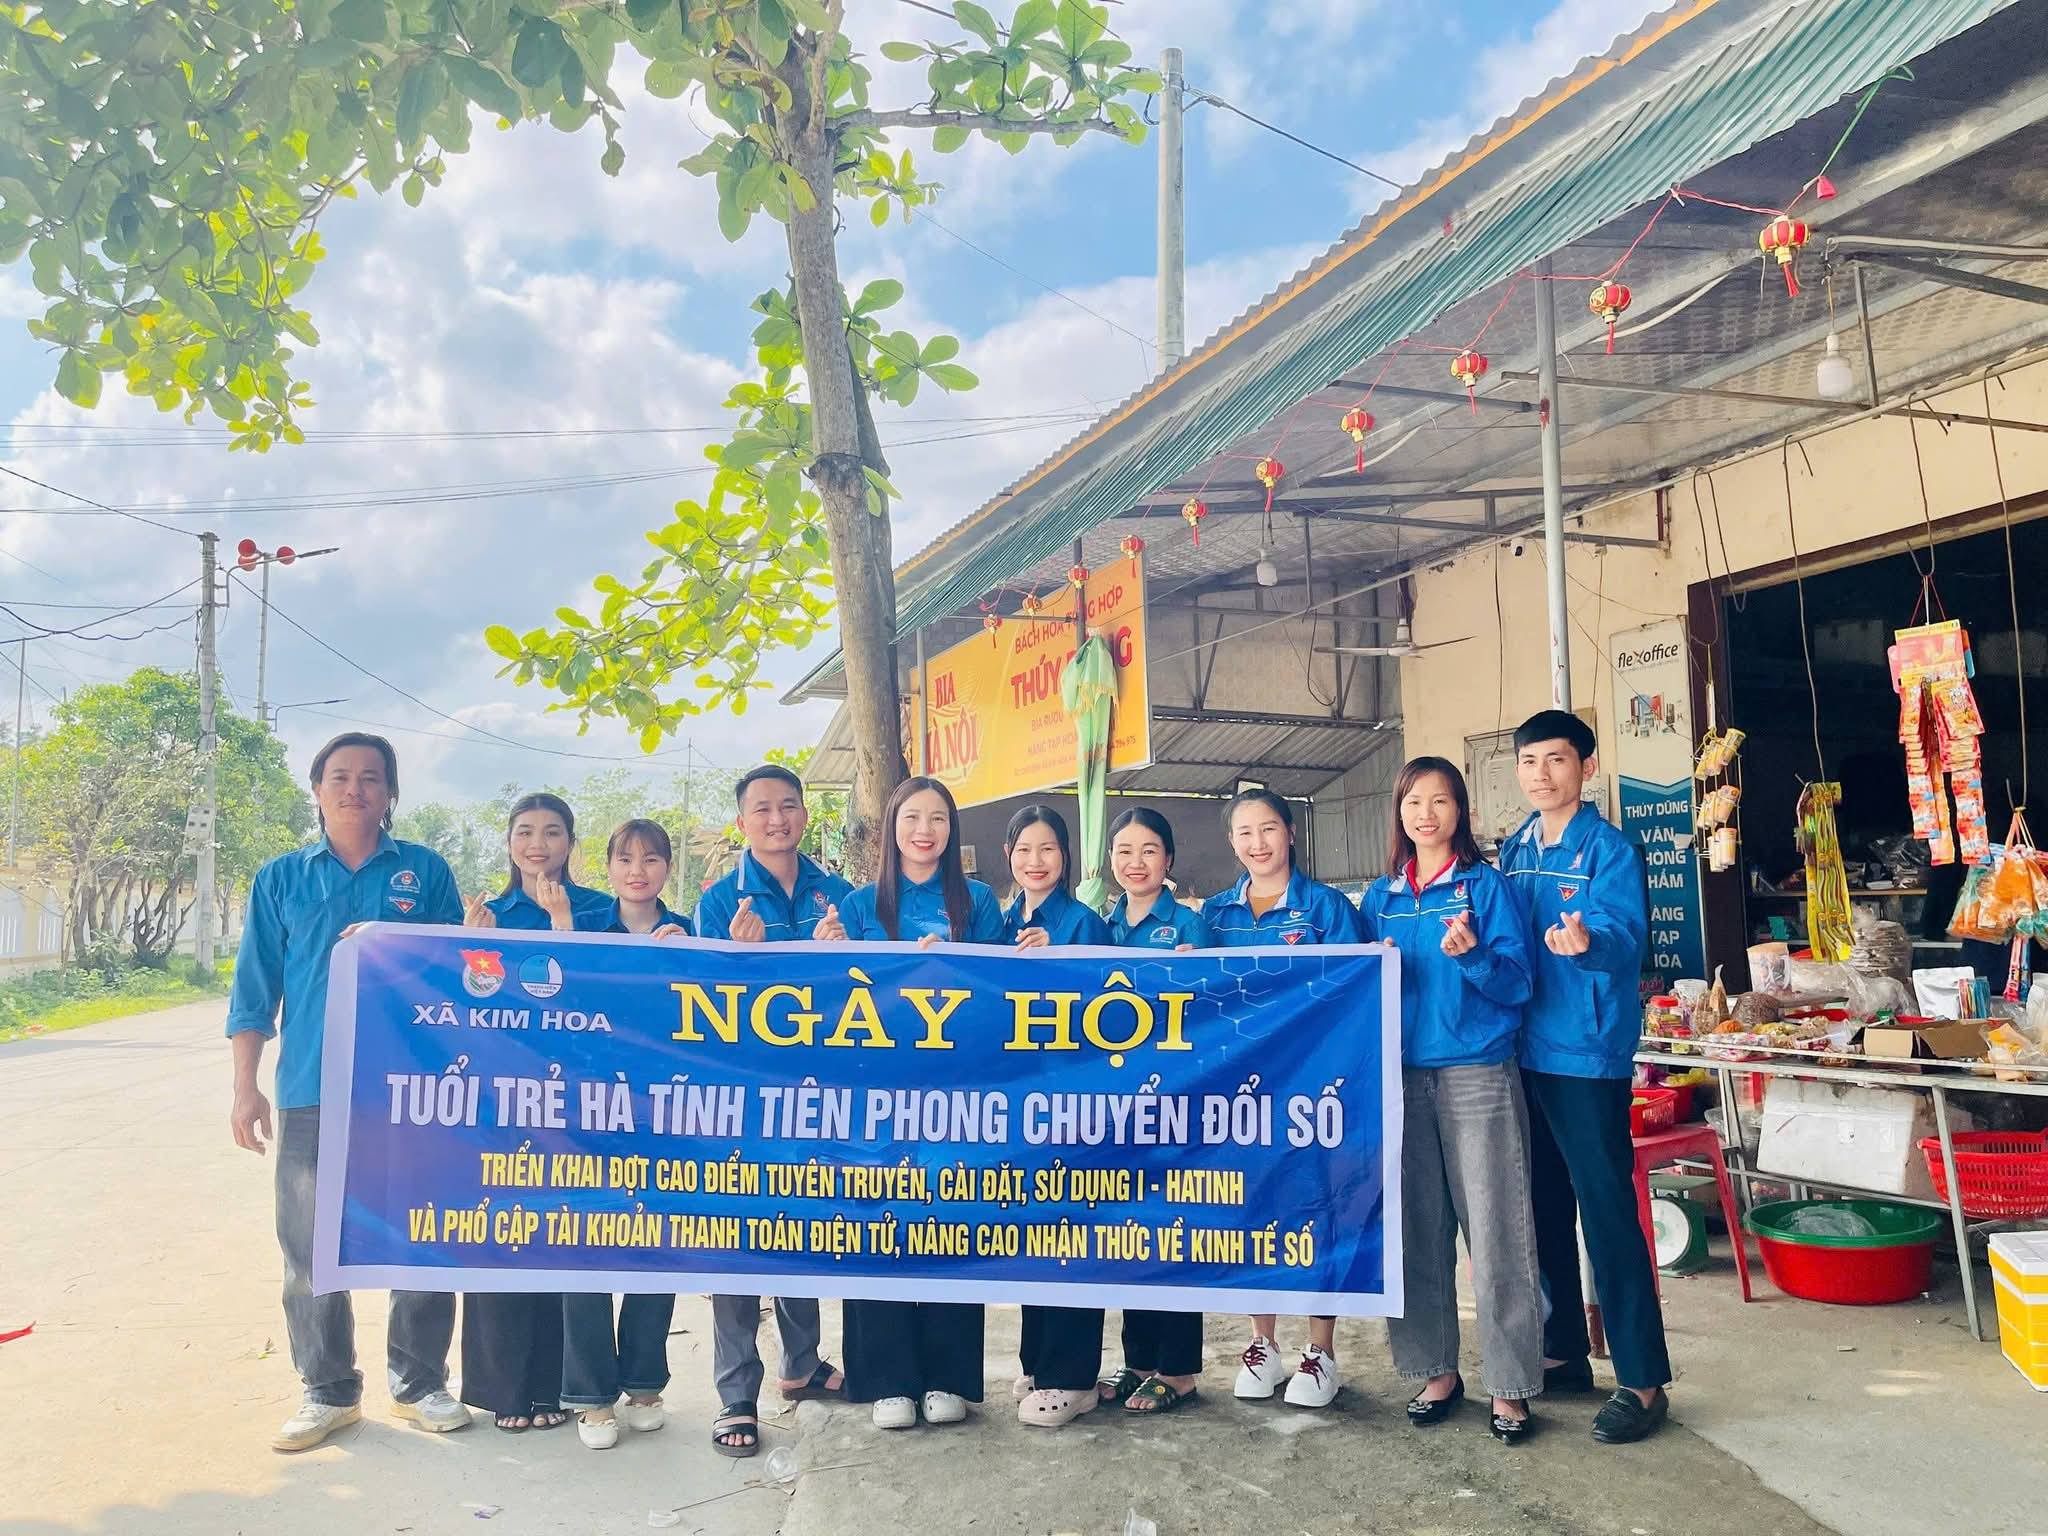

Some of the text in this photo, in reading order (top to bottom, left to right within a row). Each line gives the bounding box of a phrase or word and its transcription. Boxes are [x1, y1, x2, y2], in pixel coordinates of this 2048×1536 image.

[1099, 585, 1123, 614] HỢP
[934, 671, 957, 709] BIA
[1010, 654, 1062, 709] THÚY
[945, 704, 979, 777] NỘI
[1640, 826, 1675, 843] VĂN
[1646, 848, 1687, 866] HÒNG
[1647, 868, 1684, 889] HẨM
[1651, 904, 1684, 921] ÀNG
[412, 1001, 613, 1033] XÃ KIM HOA
[670, 966, 1195, 1068] NGÀY HỘI
[386, 1054, 1345, 1149] TUỔI TRẺ HÀ TĨNH TIÊN PHONG CHUYỂN ĐỔI SỐ
[481, 1139, 545, 1187] TRIỂN
[550, 1154, 602, 1188] KHAI
[608, 1155, 650, 1196] ĐỢT
[655, 1159, 698, 1192] CAO
[704, 1150, 759, 1195] ĐIỂM
[766, 1158, 835, 1198] TUYÊN
[841, 1156, 932, 1205] TRUYỀN,
[939, 1162, 976, 1202] CÀI
[982, 1163, 1027, 1208] ĐẶT,
[1034, 1159, 1066, 1202] SỬ
[1070, 1169, 1131, 1208] DỤNG
[1137, 1169, 1144, 1201] I
[1166, 1169, 1244, 1205] HATINH
[408, 1197, 1315, 1267] VÀ PHỔ CẬP TÀI KHOẢN THANH TOÁN ĐIỆN TỬ, NÂNG CAO NHẬN THỨC VỀ KINH TẾ SỐ
